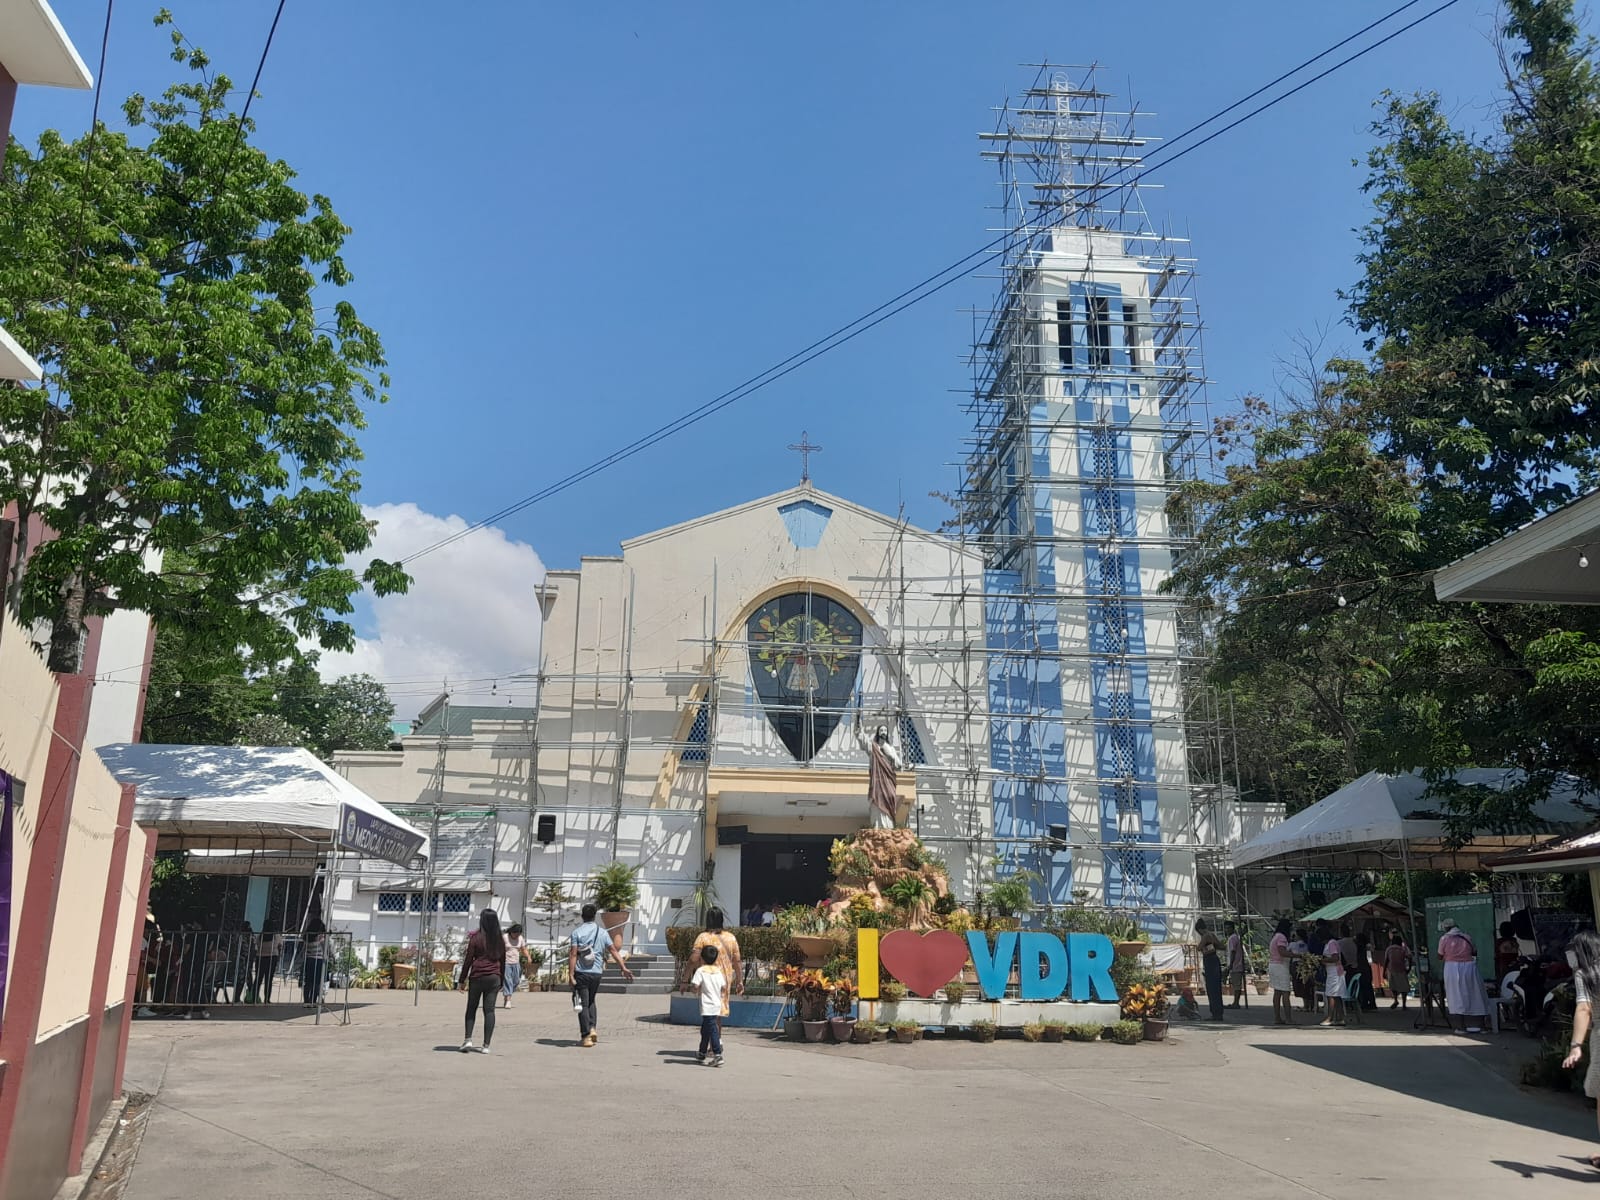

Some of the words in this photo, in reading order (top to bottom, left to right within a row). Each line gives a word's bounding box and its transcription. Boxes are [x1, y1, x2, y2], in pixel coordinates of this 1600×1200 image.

[354, 826, 384, 854] MEDICAL
[382, 838, 410, 861] STATION
[857, 928, 879, 999] I
[966, 929, 1119, 1000] VDR
